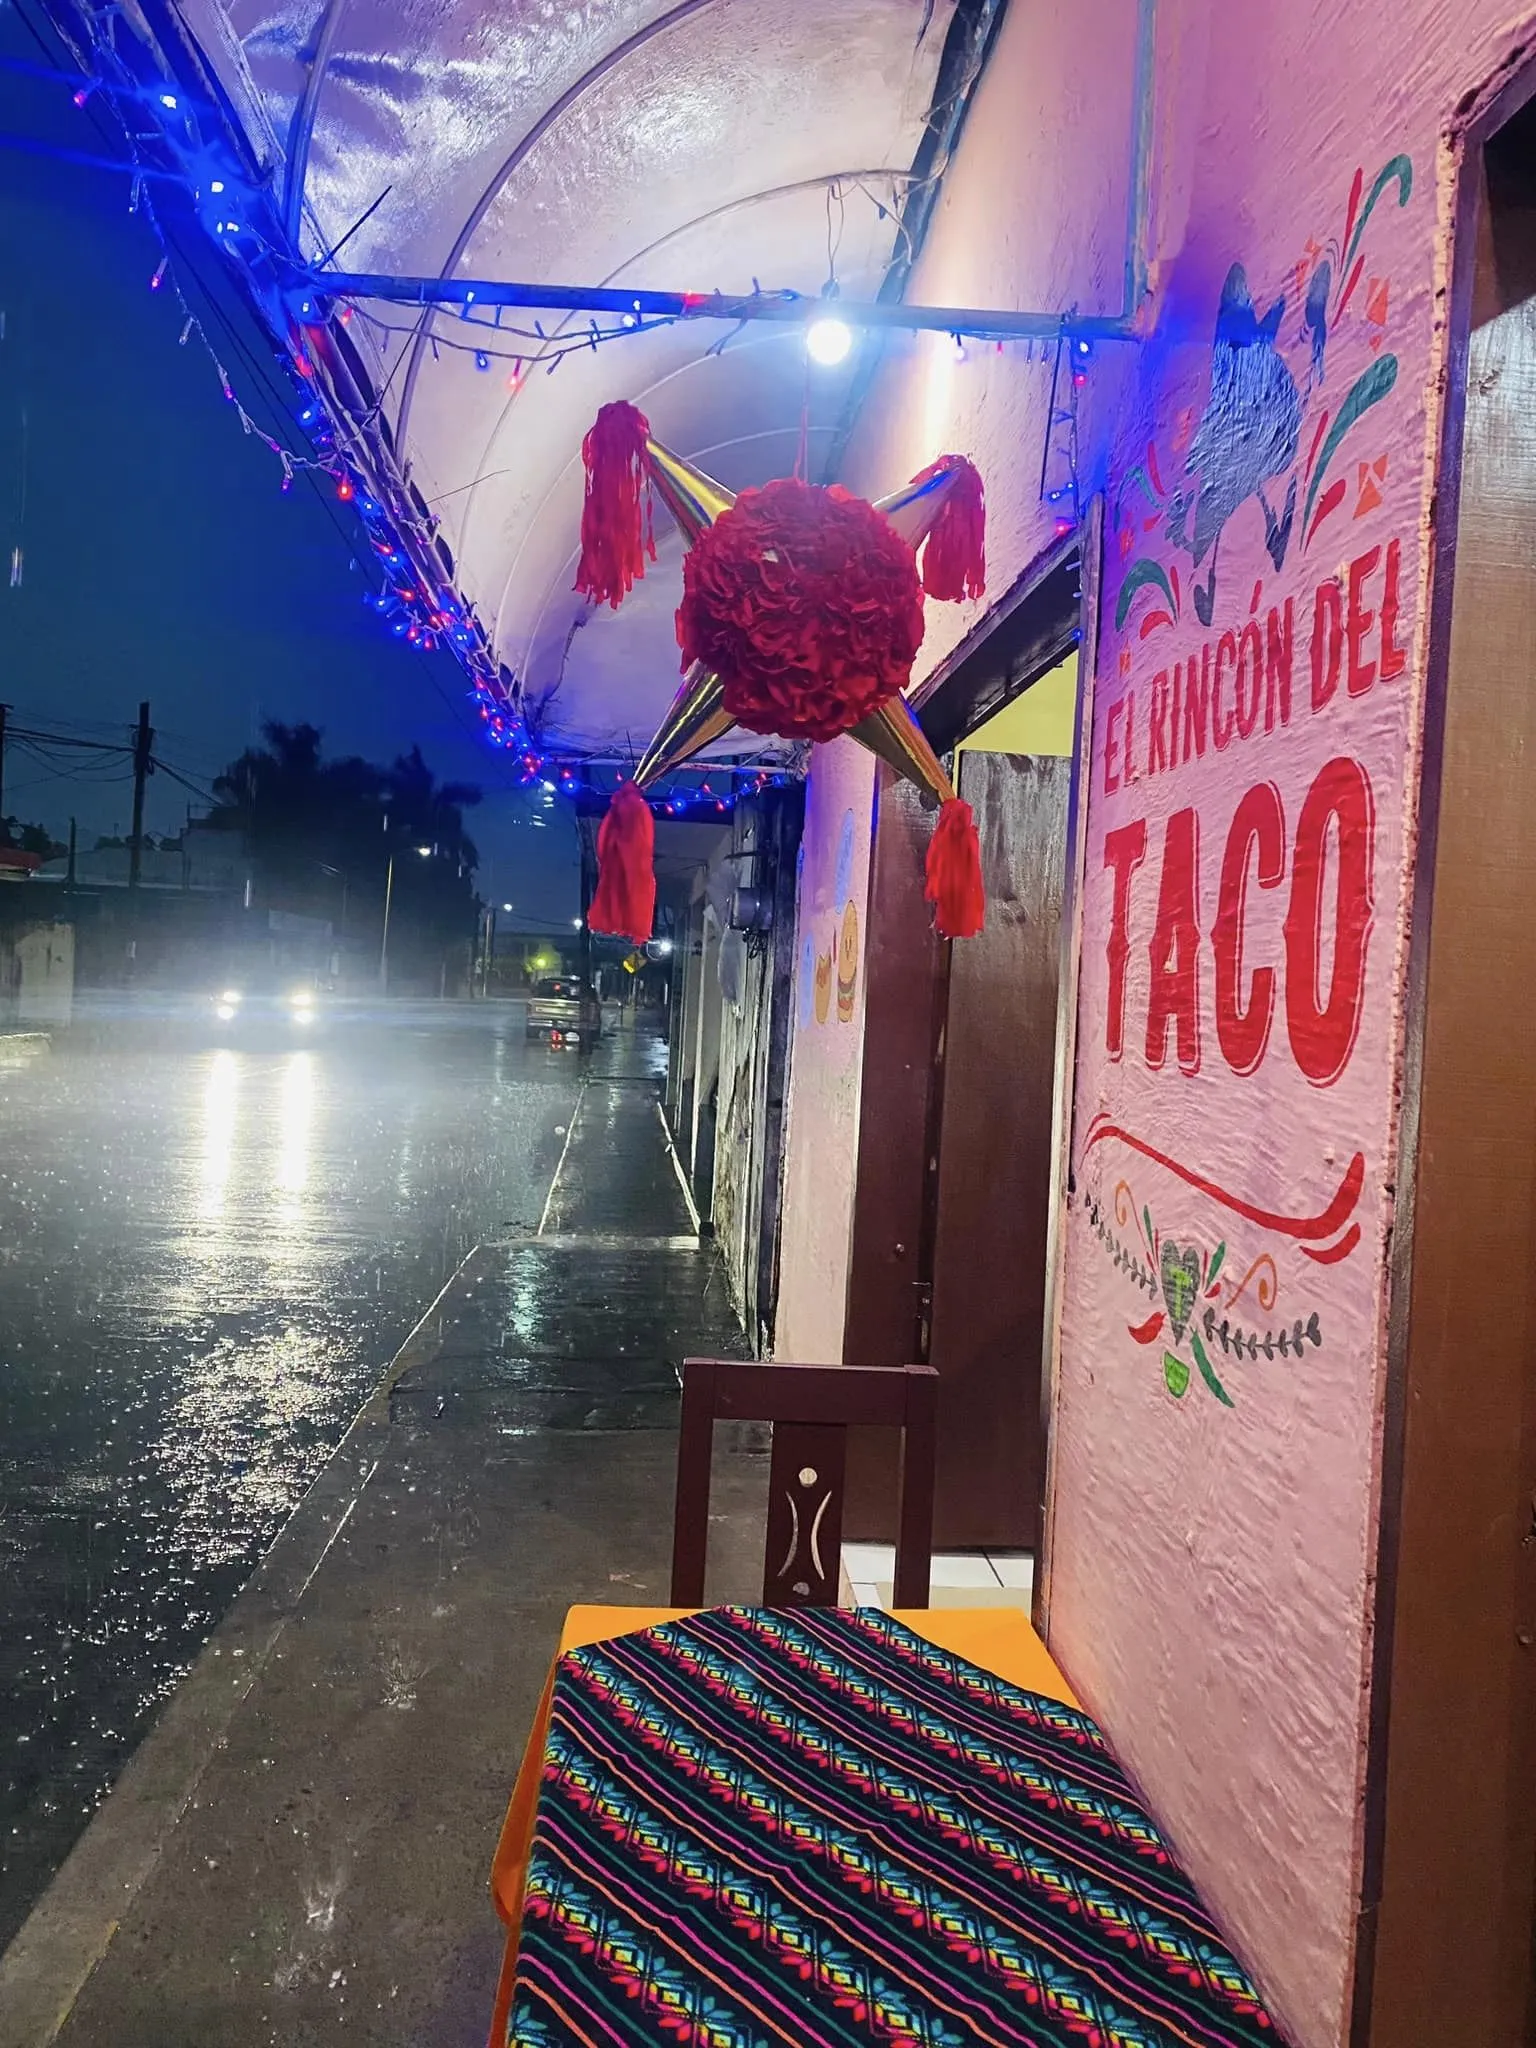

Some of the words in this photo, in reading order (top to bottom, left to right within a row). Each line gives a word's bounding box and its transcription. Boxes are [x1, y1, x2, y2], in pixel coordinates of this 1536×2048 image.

[1104, 691, 1136, 796] EL
[1149, 581, 1294, 776] RINCÓN
[1311, 538, 1405, 714] DEL
[1104, 757, 1375, 1088] TACO
